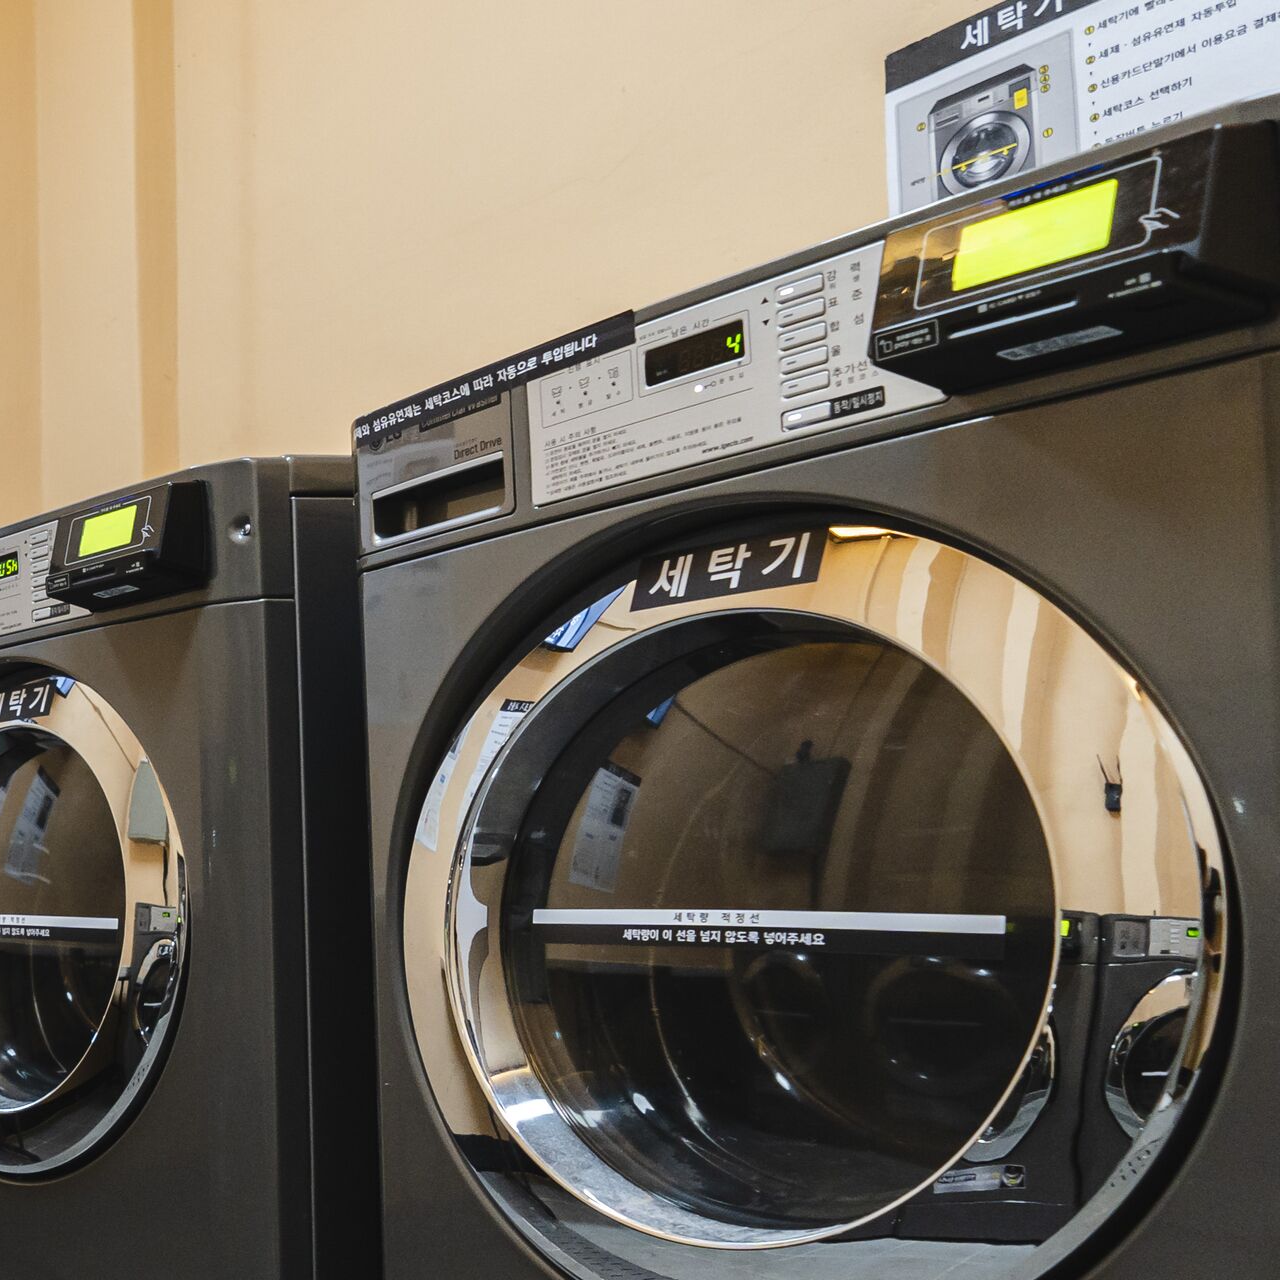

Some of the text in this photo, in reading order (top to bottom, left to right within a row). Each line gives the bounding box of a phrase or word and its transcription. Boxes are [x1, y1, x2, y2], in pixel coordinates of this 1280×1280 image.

[1097, 6, 1139, 30] 세탁기에
[1098, 44, 1120, 58] 세제
[1131, 18, 1185, 47] 섬유유연제
[1191, 0, 1237, 22] 자동투입
[1100, 44, 1197, 89] 신용카드단말기에서
[1201, 24, 1248, 49] 이용요금
[1253, 12, 1280, 30] 결제
[1102, 96, 1145, 118] 세탁코스
[1149, 76, 1193, 100] 선택하기
[726, 333, 741, 353] 4
[372, 404, 421, 432] 섬유유연제는
[425, 382, 470, 410] 세탁코스에
[473, 374, 493, 391] 따라
[497, 356, 538, 381] 자동으로
[541, 333, 598, 365] 투입됩니다
[454, 437, 502, 460] Direct Drive
[649, 532, 811, 597] 세탁기
[673, 912, 761, 924] 세탁량 적정선
[623, 929, 825, 945] 세탁량이 이 선을 넘지 않도록 넣어주세요
